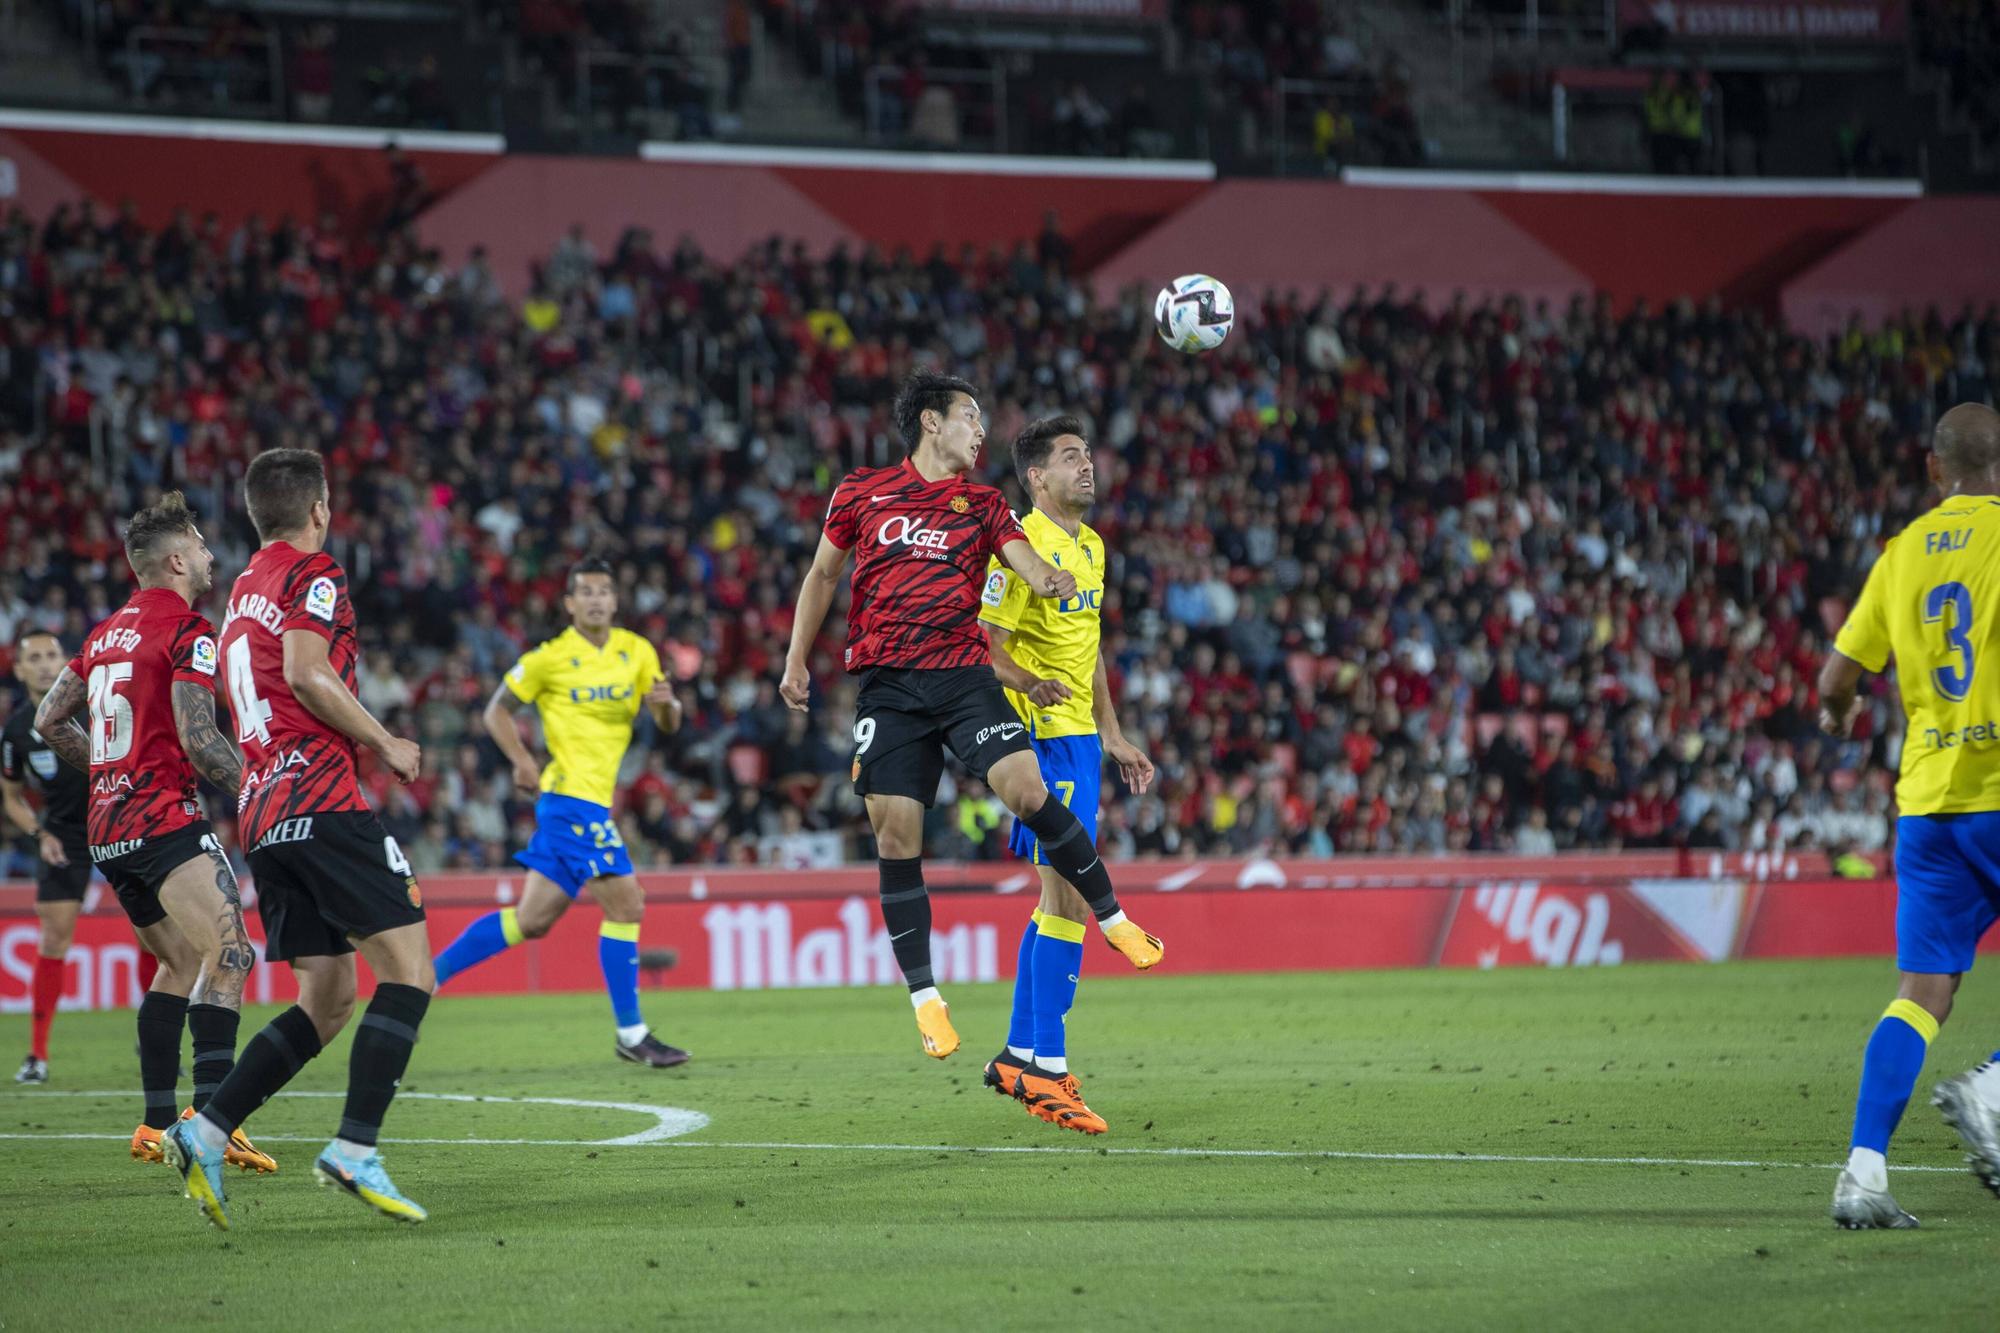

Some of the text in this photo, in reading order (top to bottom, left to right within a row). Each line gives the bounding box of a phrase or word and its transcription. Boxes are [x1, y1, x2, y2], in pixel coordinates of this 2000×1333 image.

[912, 547, 948, 561] by Taica
[1926, 528, 1974, 555] FALI
[1922, 581, 1975, 702] 3
[226, 632, 273, 748] 4
[87, 661, 134, 765] 15
[247, 749, 311, 785] ALUA
[1055, 780, 1075, 809] 7
[589, 819, 623, 849] 23
[383, 835, 412, 876] 4
[702, 896, 998, 990] Mahu
